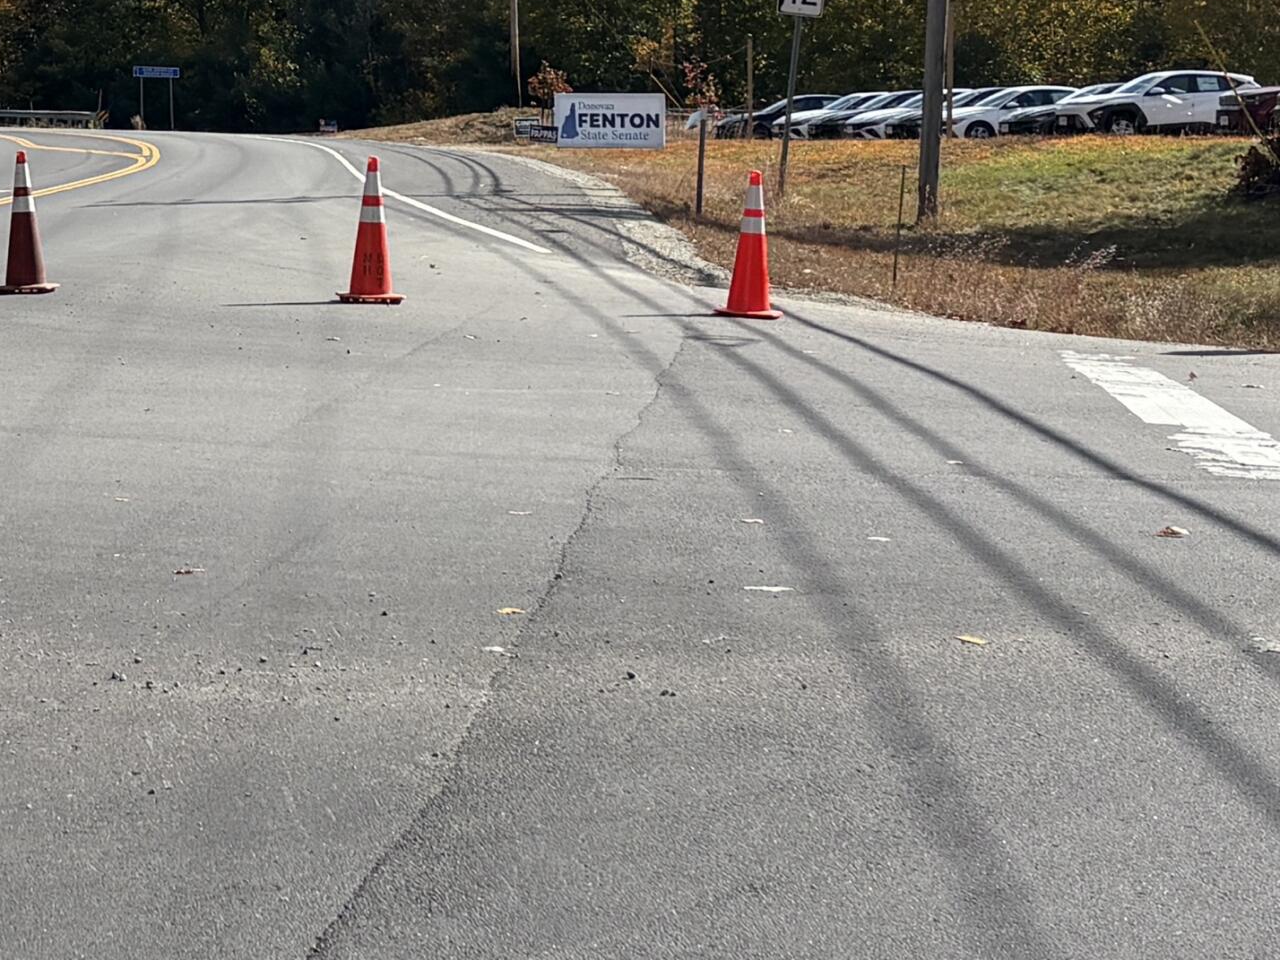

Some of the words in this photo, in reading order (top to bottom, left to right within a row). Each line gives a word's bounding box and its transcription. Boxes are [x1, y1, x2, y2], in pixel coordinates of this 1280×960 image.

[578, 101, 615, 110] Donovan
[578, 113, 660, 128] FENTON
[580, 129, 608, 140] State
[611, 129, 650, 140] Senate
